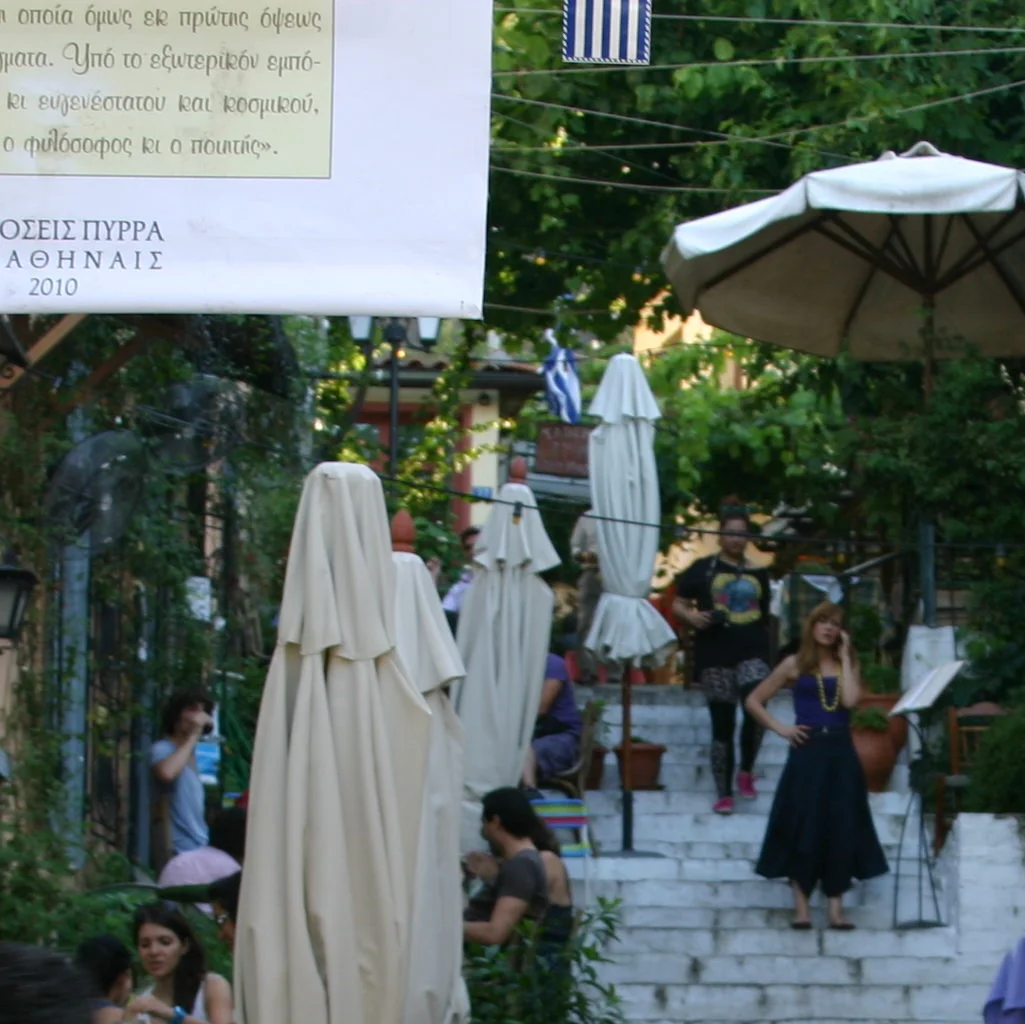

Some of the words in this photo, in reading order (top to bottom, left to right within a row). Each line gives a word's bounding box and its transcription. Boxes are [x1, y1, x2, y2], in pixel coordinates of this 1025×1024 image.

[18, 4, 73, 25] οποία
[85, 4, 132, 32] όμως
[143, 9, 168, 26] εκ
[179, 6, 249, 33] πρώτης
[260, 6, 322, 34] όψεως
[62, 42, 115, 75] Υπό
[122, 53, 142, 69] το
[150, 44, 259, 76] εξωτερικόν
[267, 50, 321, 77] εμπό-
[7, 92, 27, 110] κι
[38, 90, 166, 117] ευγενέστατου
[178, 94, 212, 112] και
[3, 135, 15, 152] ο
[142, 136, 161, 154] κι
[170, 138, 182, 154] ο
[82, 219, 165, 242] ΠΥΡΡΑ
[5, 249, 163, 270] ΑΘΗΝΑΙΣ
[28, 277, 78, 296] 2010
